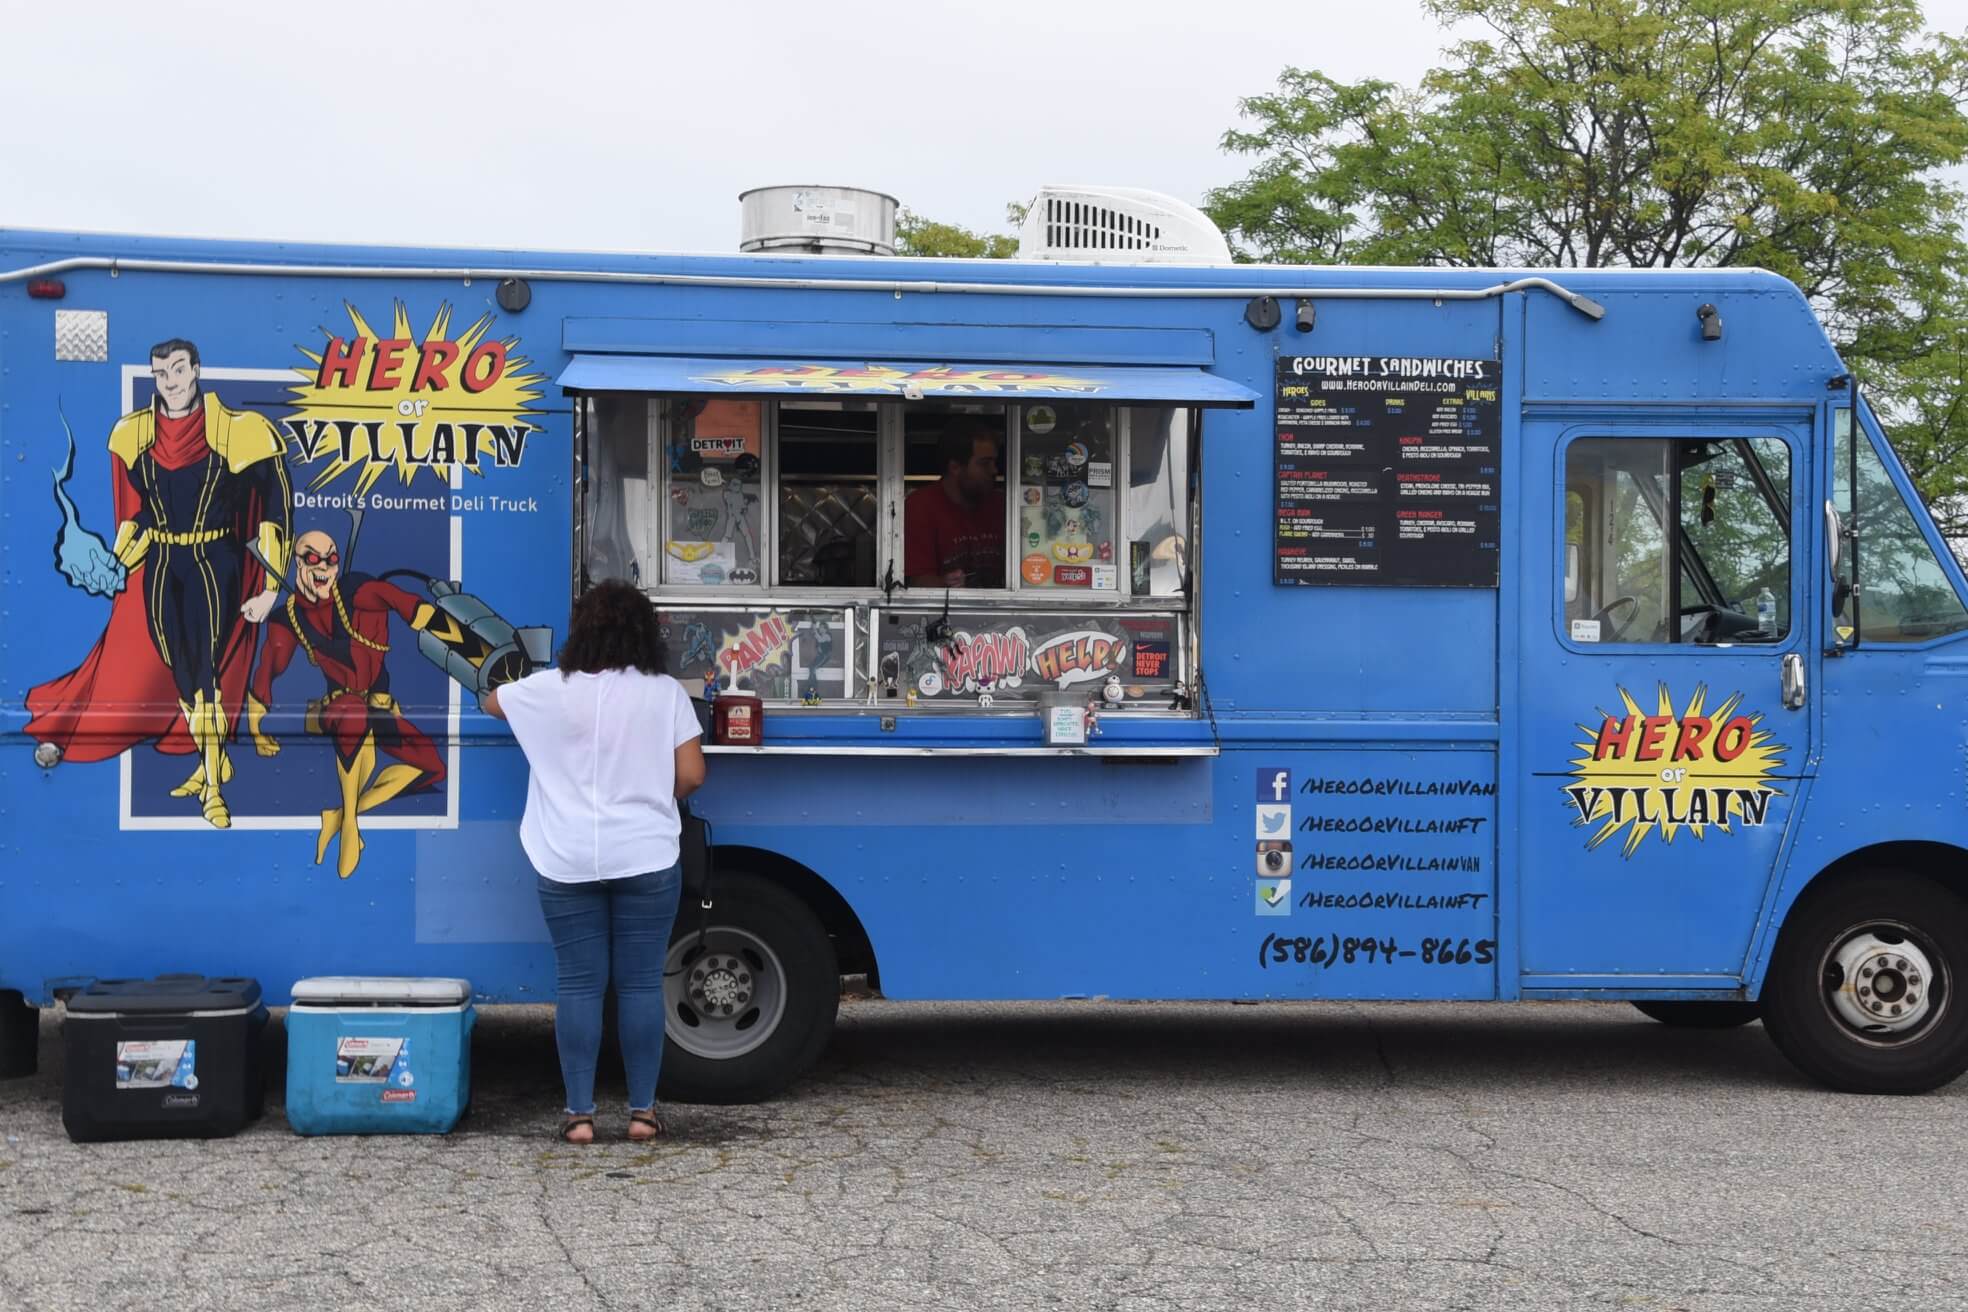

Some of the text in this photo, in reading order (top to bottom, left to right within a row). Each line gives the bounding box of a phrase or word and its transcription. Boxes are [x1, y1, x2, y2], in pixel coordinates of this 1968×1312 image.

[315, 337, 507, 393] HERO
[1292, 357, 1484, 379] GOURMET SANDWICHES
[398, 400, 430, 418] or
[283, 419, 532, 468] VILLAIN
[293, 492, 538, 512] Detroit's Gourmet Deli Truck
[1035, 639, 1126, 680] HELP!
[1136, 660, 1160, 668] NEVER
[1136, 668, 1159, 676] STOPS
[1592, 715, 1753, 763] HERO
[1660, 767, 1687, 783] or
[1566, 786, 1775, 827] VILLAIN
[1259, 932, 1497, 969] (586)894-8665
